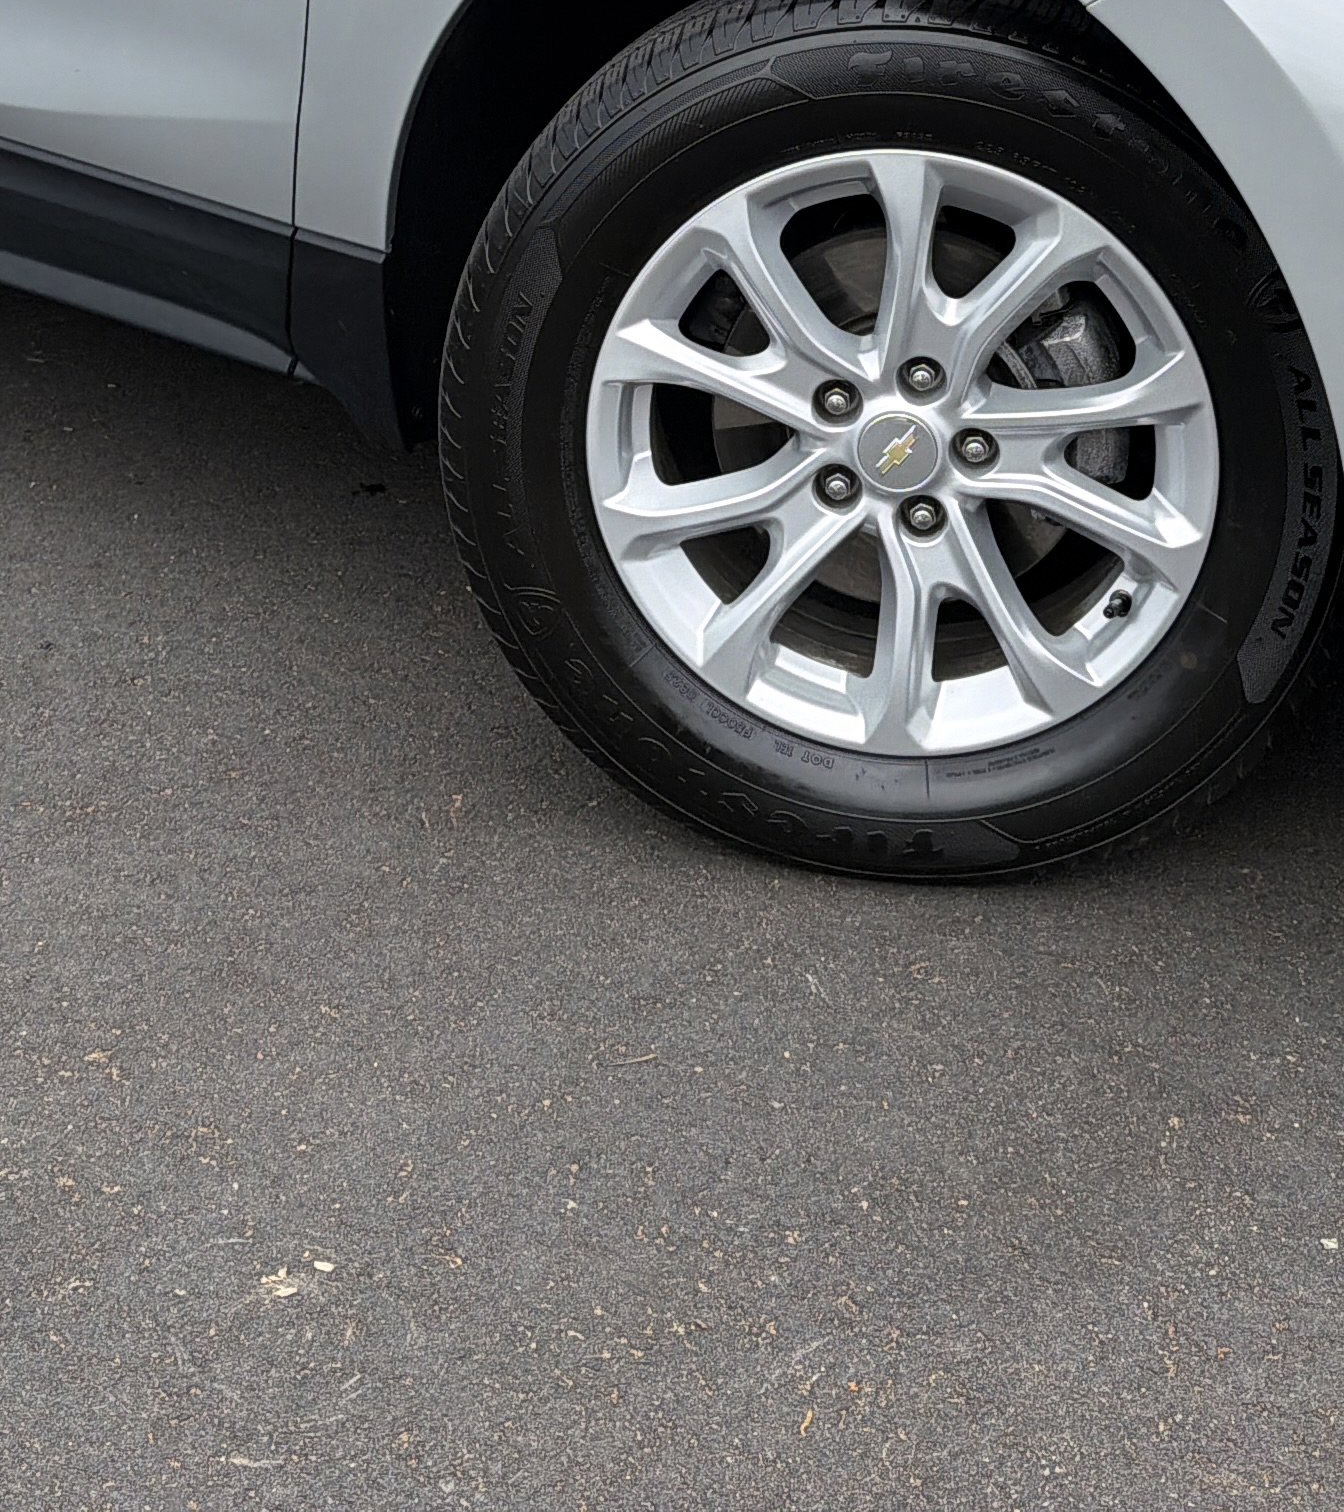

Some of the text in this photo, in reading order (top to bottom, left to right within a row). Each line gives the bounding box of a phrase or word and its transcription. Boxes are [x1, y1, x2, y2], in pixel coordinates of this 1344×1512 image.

[1269, 365, 1324, 639] ALL SEASON
[800, 751, 836, 770] DOT
